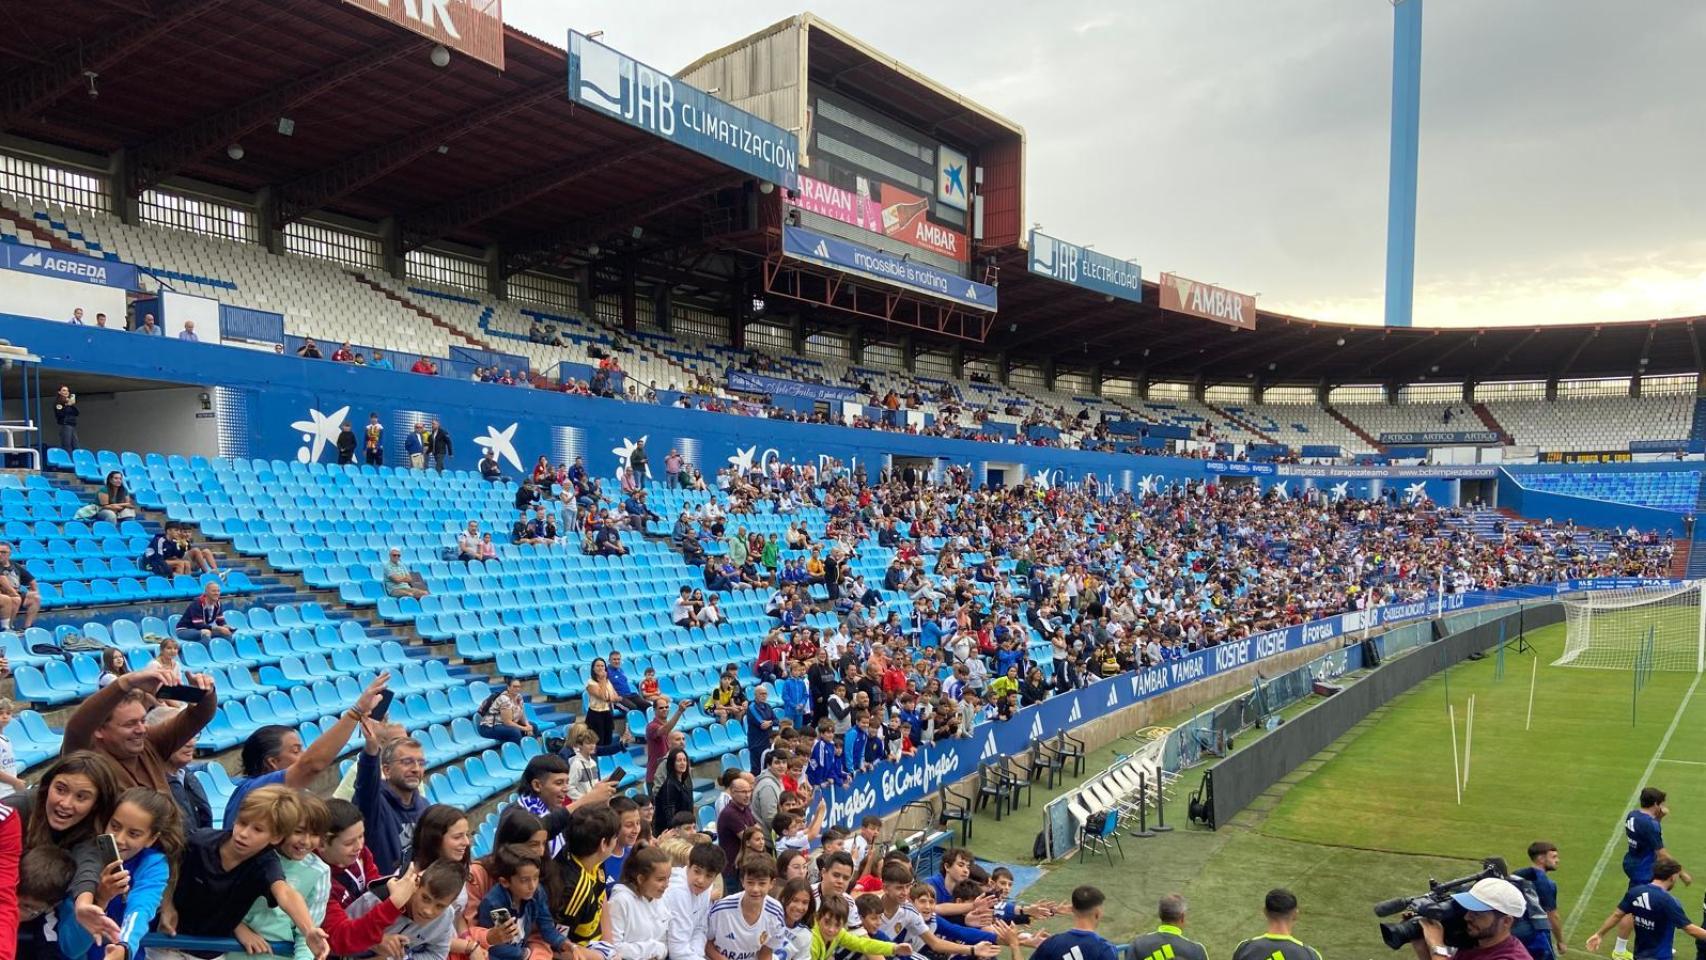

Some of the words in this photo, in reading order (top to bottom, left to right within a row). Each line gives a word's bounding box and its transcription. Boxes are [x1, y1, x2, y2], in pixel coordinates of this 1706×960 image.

[624, 67, 676, 136] JAB
[681, 104, 796, 173] CLIMATIZACIÓN
[784, 175, 852, 212] ARAVAN
[915, 221, 957, 253] AMBAR
[43, 257, 107, 279] AGREDA
[853, 248, 906, 278] impossible
[906, 266, 915, 281] is
[915, 269, 948, 293] nothing
[1053, 240, 1078, 283] JAB
[1082, 260, 1138, 290] ELECTRICIDAD
[1191, 286, 1244, 323] AMBAR
[1137, 667, 1168, 696] AMBAR
[1177, 656, 1204, 683] AMBAR
[881, 769, 896, 802] El
[895, 764, 923, 795] Corte
[922, 748, 960, 794] Inglés
[828, 780, 877, 829] Inglés
